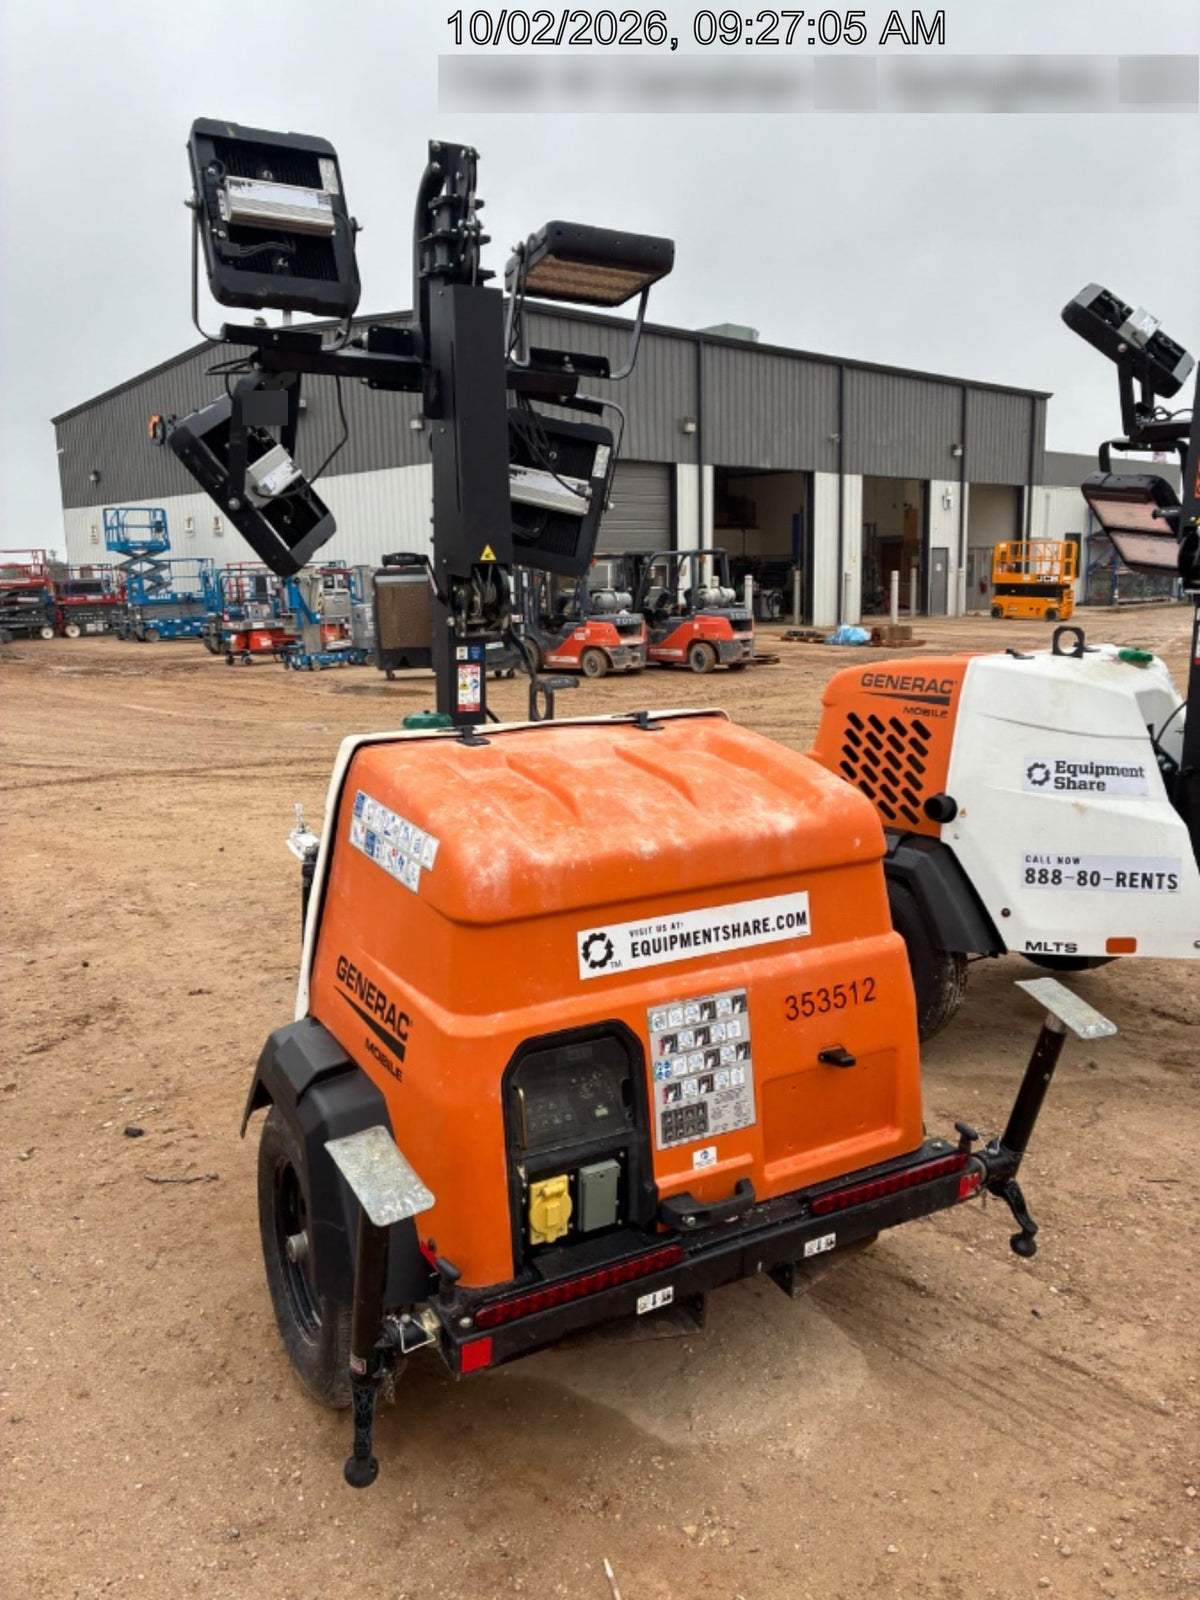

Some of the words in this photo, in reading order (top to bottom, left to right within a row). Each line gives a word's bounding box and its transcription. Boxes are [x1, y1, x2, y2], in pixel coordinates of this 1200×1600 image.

[861, 673, 954, 694] GENERAC
[903, 706, 949, 718] MOBILE
[1054, 760, 1146, 778] Equipment
[1054, 777, 1107, 791] Share
[1025, 854, 1051, 864] CALL
[1057, 856, 1081, 865] NOW
[1025, 867, 1178, 890] 888-80-RENTS
[630, 926, 653, 937] VISIT
[656, 924, 667, 933] US
[630, 911, 808, 959] EQUIPMENTSHARE.COM
[1025, 941, 1079, 954] MLTS
[336, 955, 410, 1042] GENERAC
[785, 976, 877, 1021] 353512
[365, 1037, 403, 1083] MOBILE
